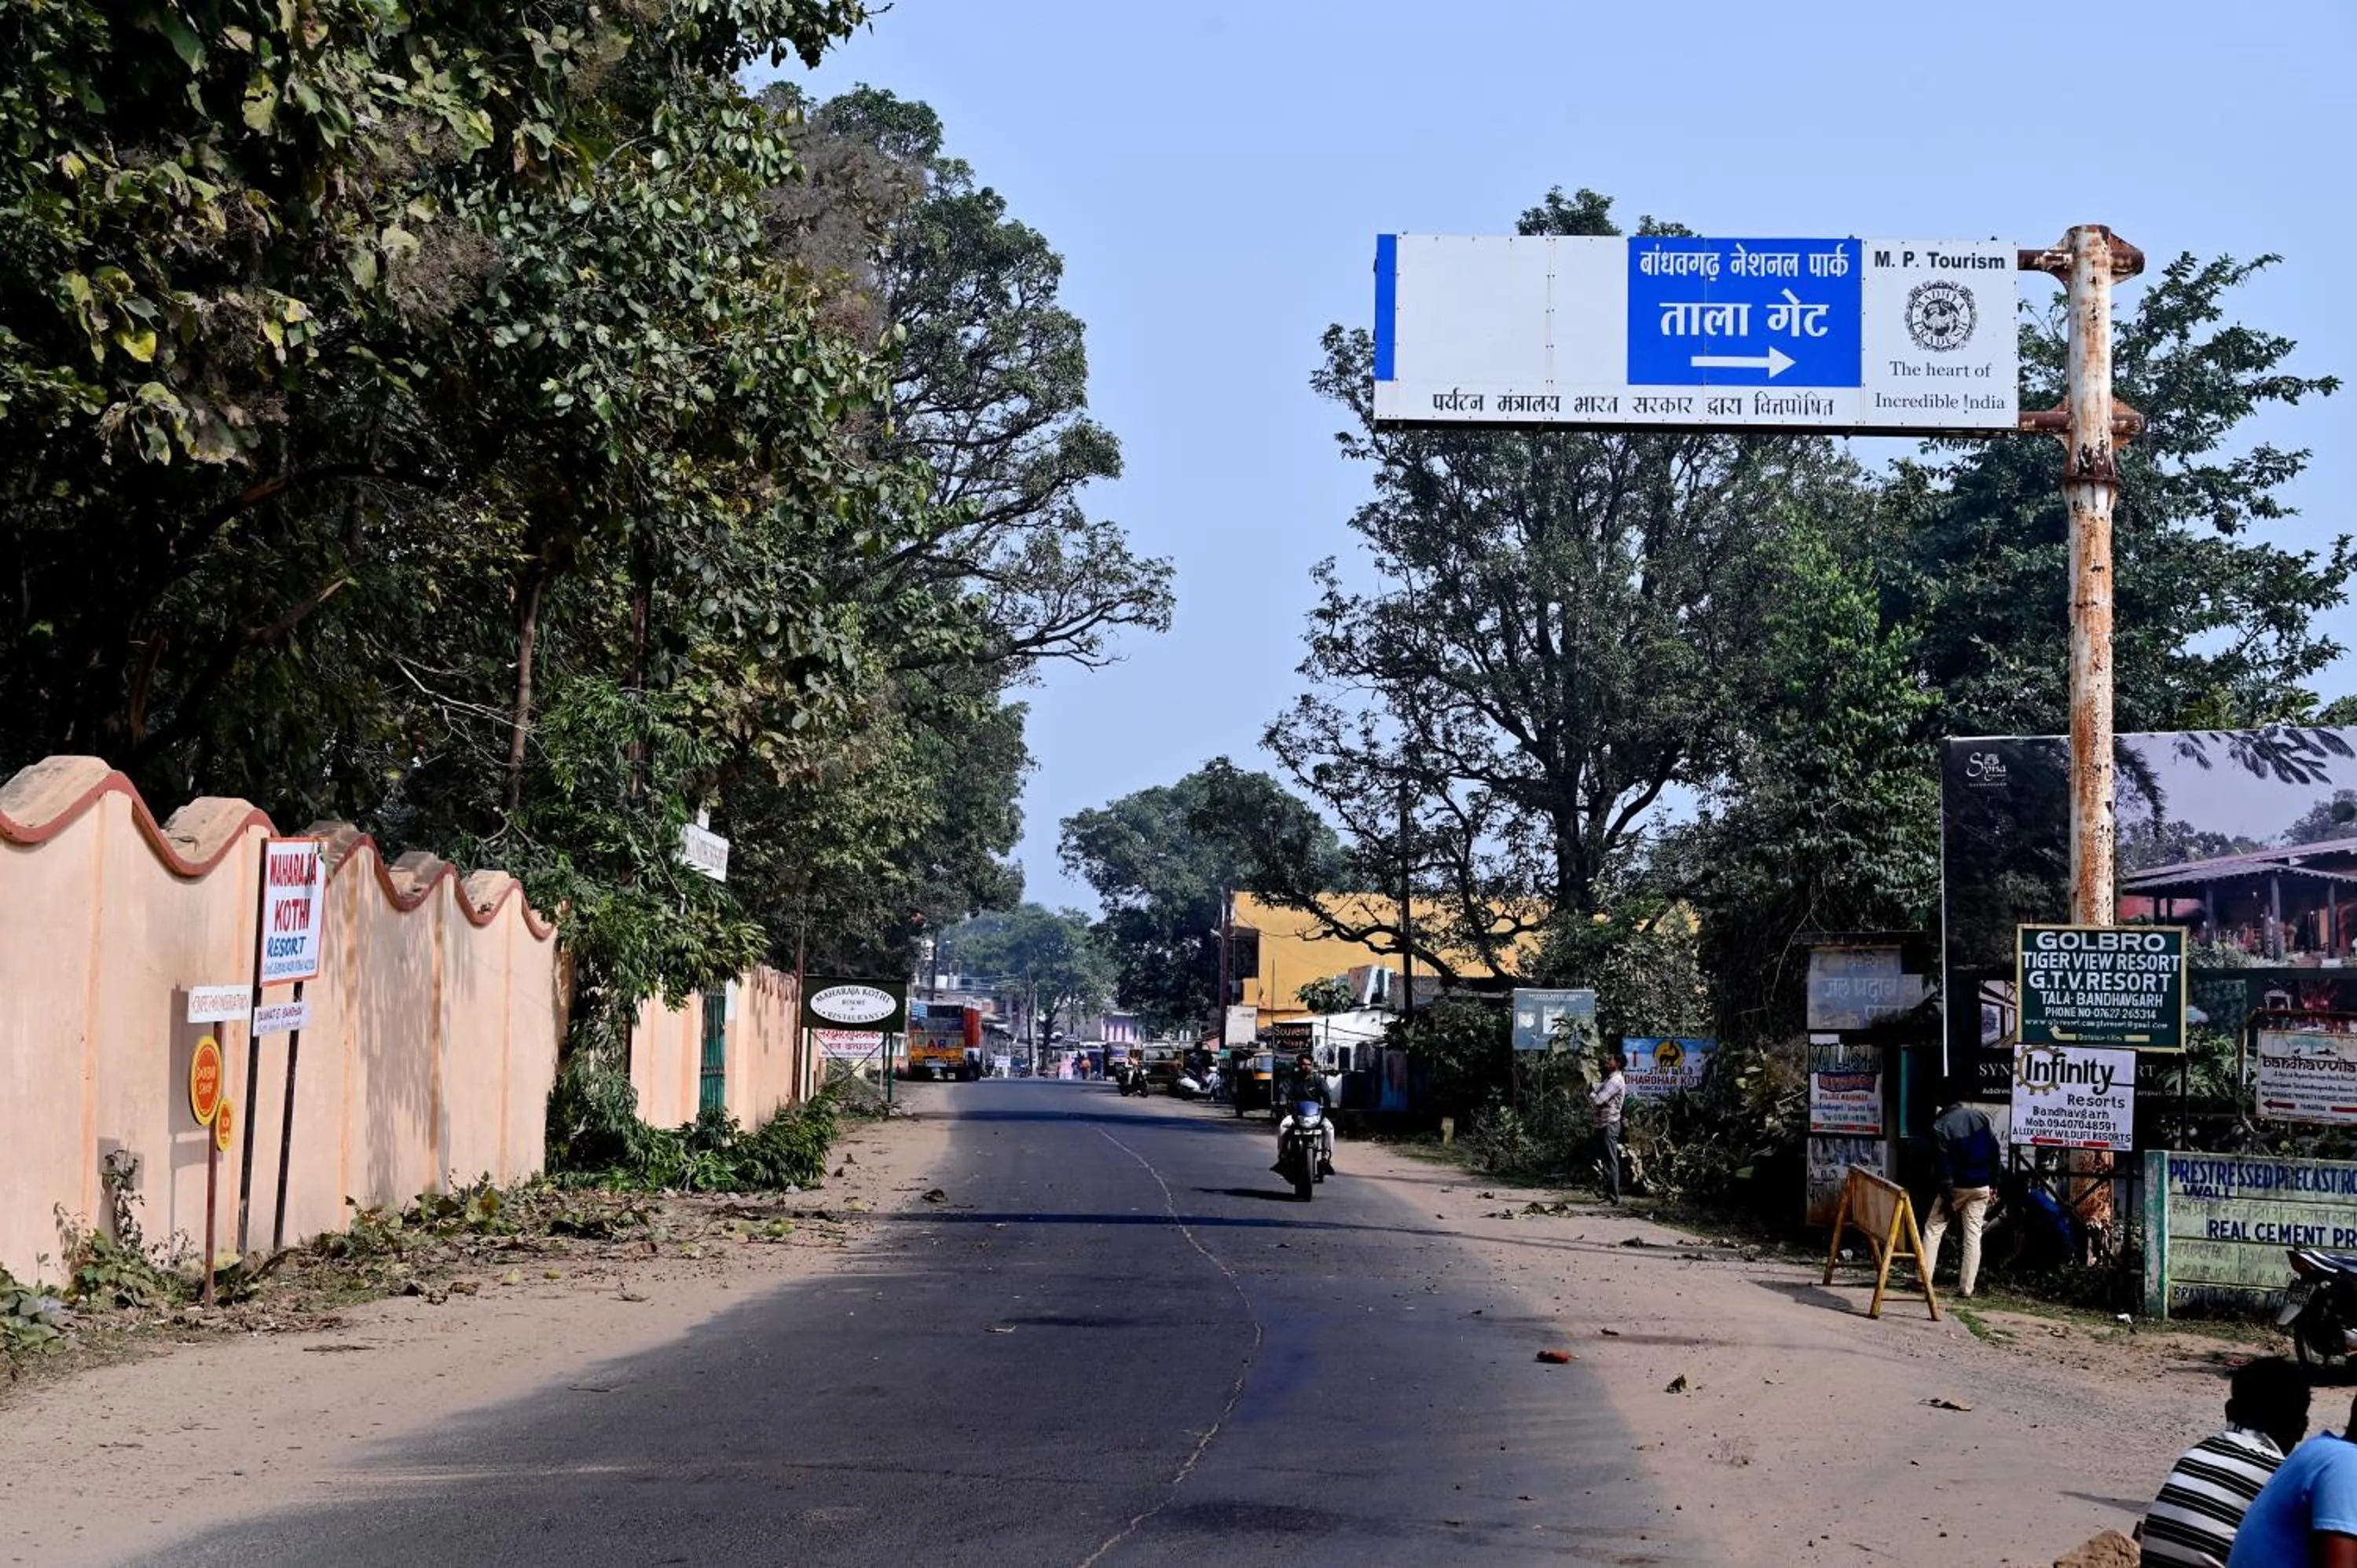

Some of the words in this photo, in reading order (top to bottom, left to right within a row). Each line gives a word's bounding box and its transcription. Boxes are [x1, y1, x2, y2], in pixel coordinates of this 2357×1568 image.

[1640, 244, 1721, 281] बांधवगढ़
[1729, 243, 1800, 277] नेशनल
[1808, 243, 1849, 277] पार्क
[1874, 251, 1896, 268] M.
[1902, 251, 1920, 268] P.
[1927, 252, 2005, 269] Tourism
[1660, 302, 1753, 337] ताला
[1765, 288, 1830, 338] गेट
[1890, 361, 1921, 377] The
[1926, 361, 1969, 378] heart
[1974, 362, 1993, 378] of
[1432, 387, 1484, 412] पर्यटन
[1497, 388, 1562, 412] मंत्रालय
[1574, 395, 1619, 414] भारत
[1632, 396, 1693, 415] सरकार
[1706, 396, 1743, 416] द्वारा
[1875, 392, 1959, 408] Incredible
[269, 853, 317, 887] MAHARAJA
[274, 898, 311, 932] KOTHI
[267, 936, 307, 958] RESORT
[2036, 932, 2166, 952] GOLBRO
[2022, 951, 2070, 969] TIGER
[2072, 951, 2114, 970] VIEW
[2116, 953, 2180, 972] RESORT
[816, 987, 860, 1003] MAHARAJA
[862, 988, 890, 1004] KOTHI
[2077, 992, 2164, 1007] BANDHAVGARH
[2045, 1006, 2076, 1017] PHONE
[1979, 1063, 2011, 1076] SYN
[2025, 1052, 2116, 1096] Infinity
[2067, 1094, 2125, 1108] Resorts
[2033, 1106, 2110, 1119] Bandhavgarh
[2169, 1159, 2272, 1190] PRESTRESSED
[2275, 1164, 2337, 1193] PRECAST
[2183, 1184, 2232, 1200] WALL
[2208, 1220, 2251, 1240] REAL
[2254, 1222, 2326, 1246] CEMENT
[2333, 1228, 2357, 1248] PR
